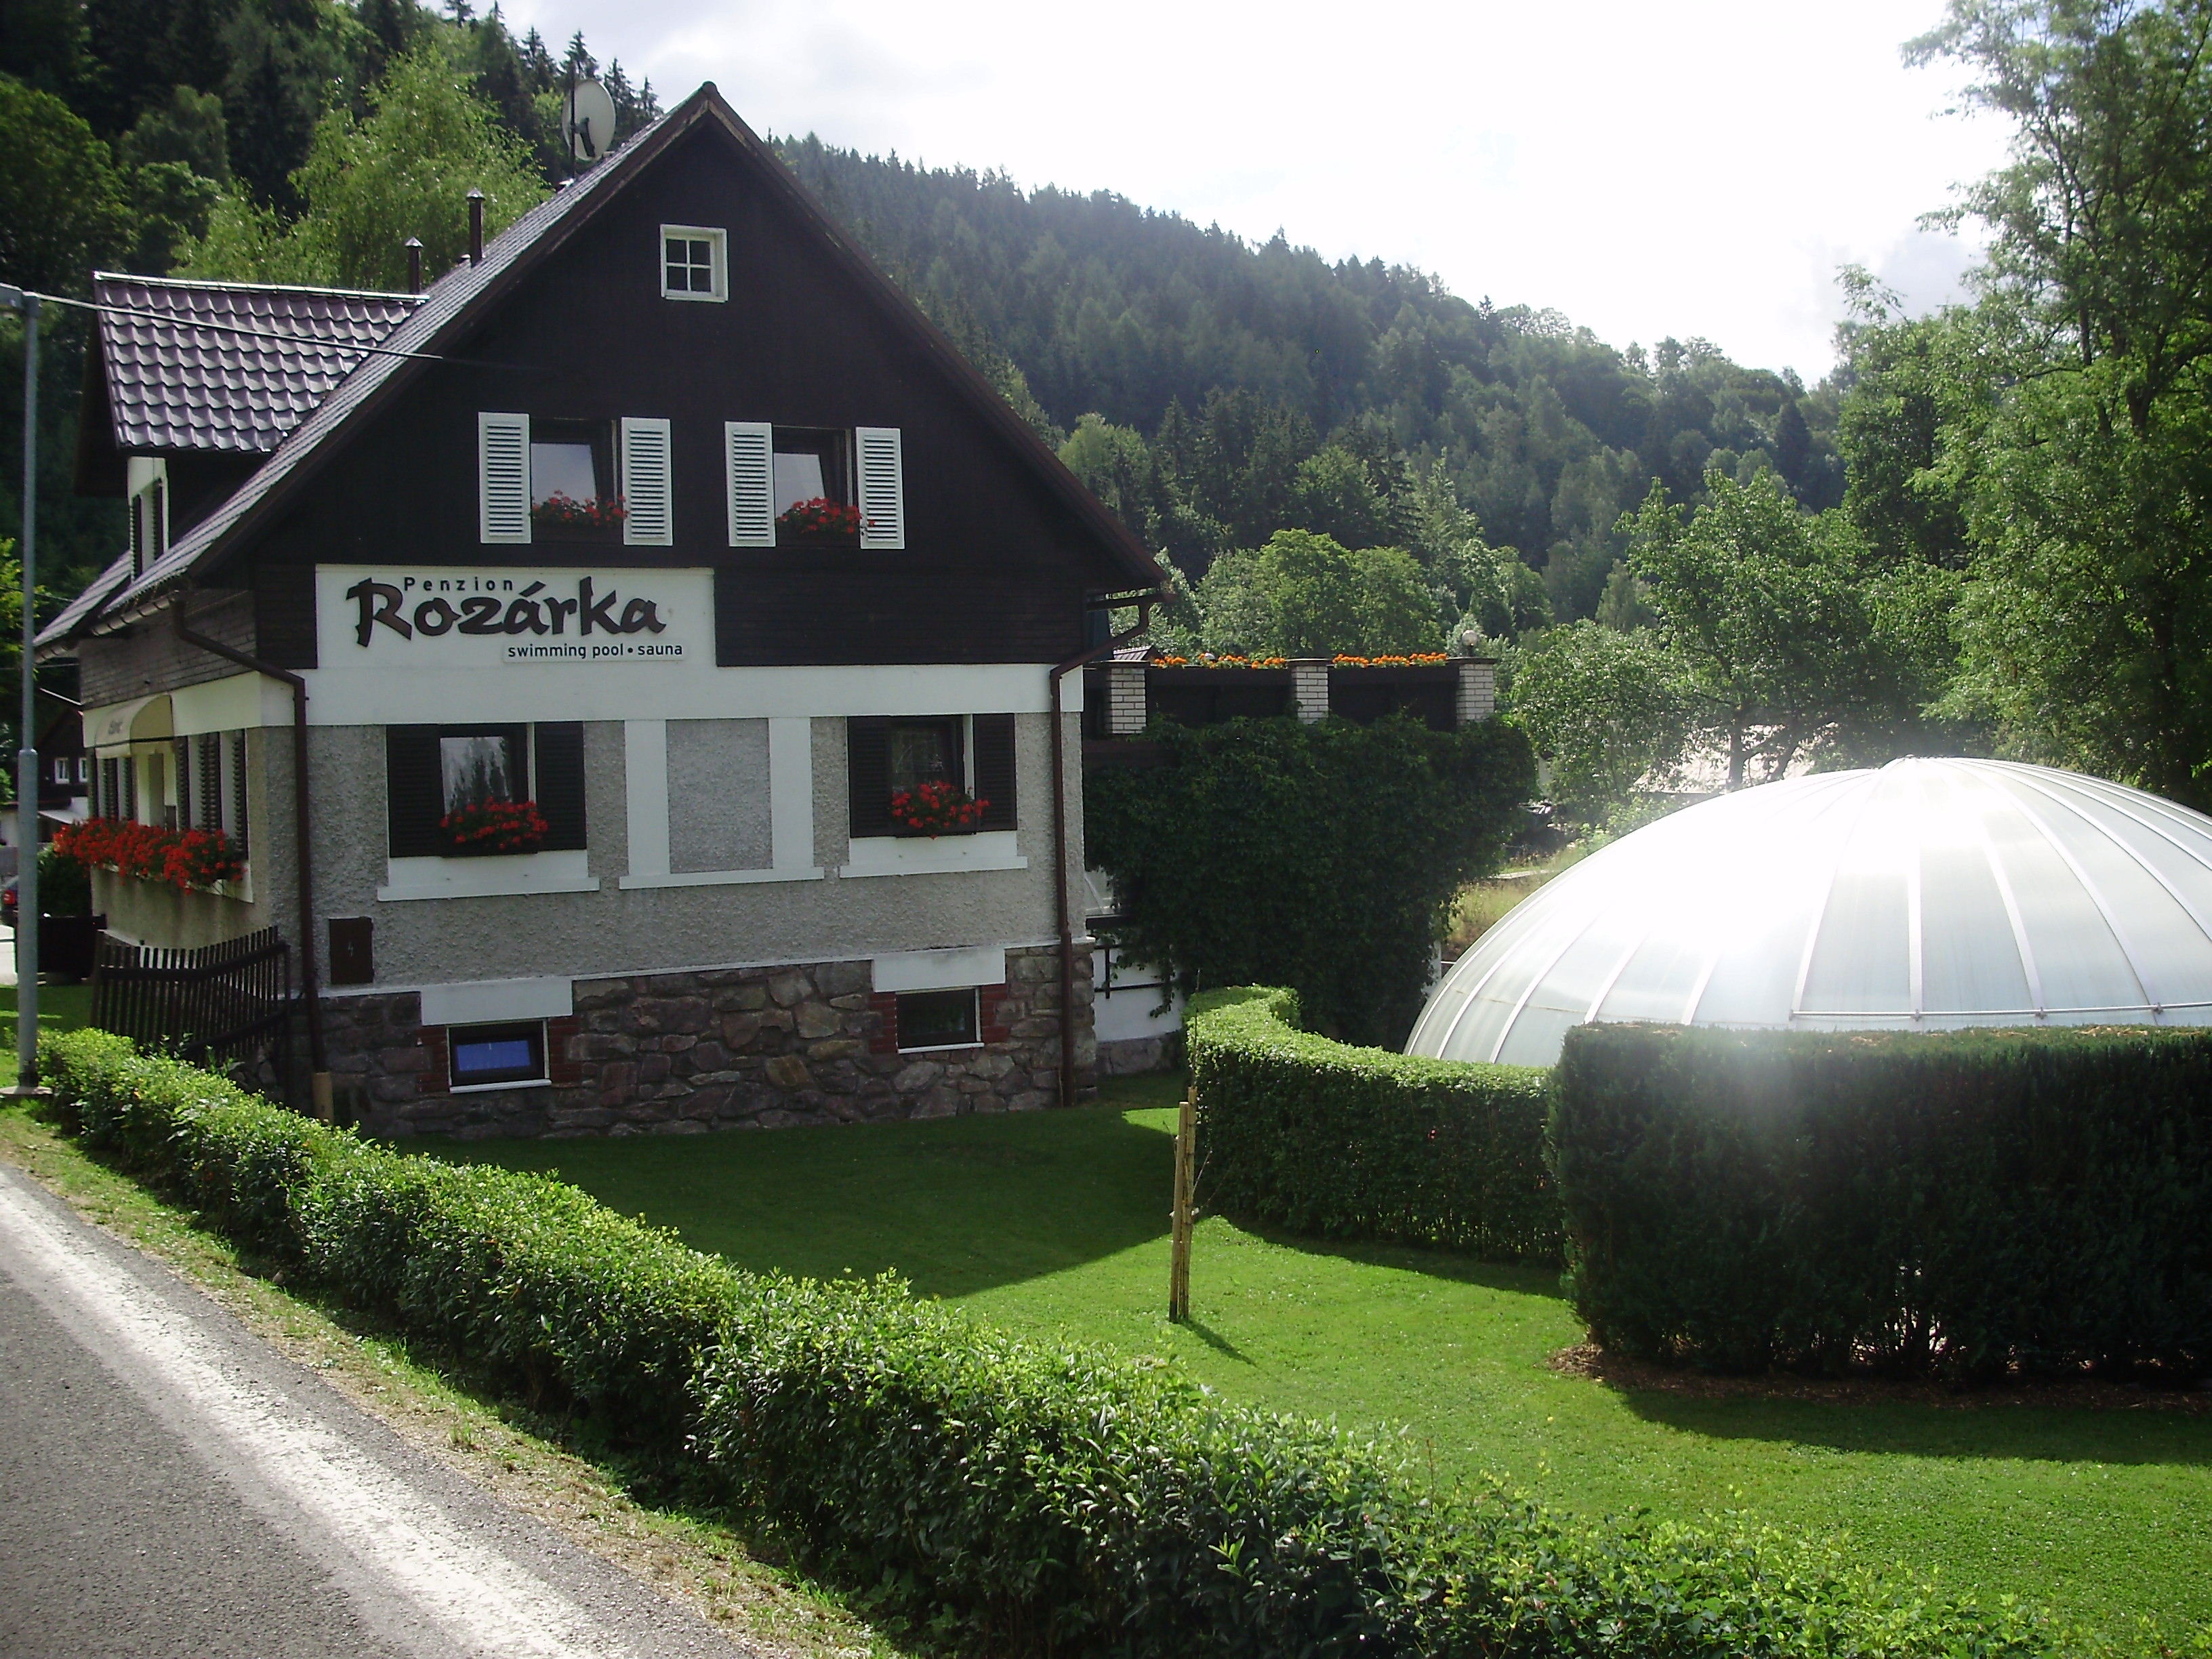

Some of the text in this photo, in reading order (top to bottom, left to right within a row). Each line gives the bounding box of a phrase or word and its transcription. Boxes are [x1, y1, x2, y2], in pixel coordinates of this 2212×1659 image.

[403, 575, 513, 592] Penzion
[344, 575, 668, 649] Rozárka
[508, 642, 682, 659] swimming pool sauna
